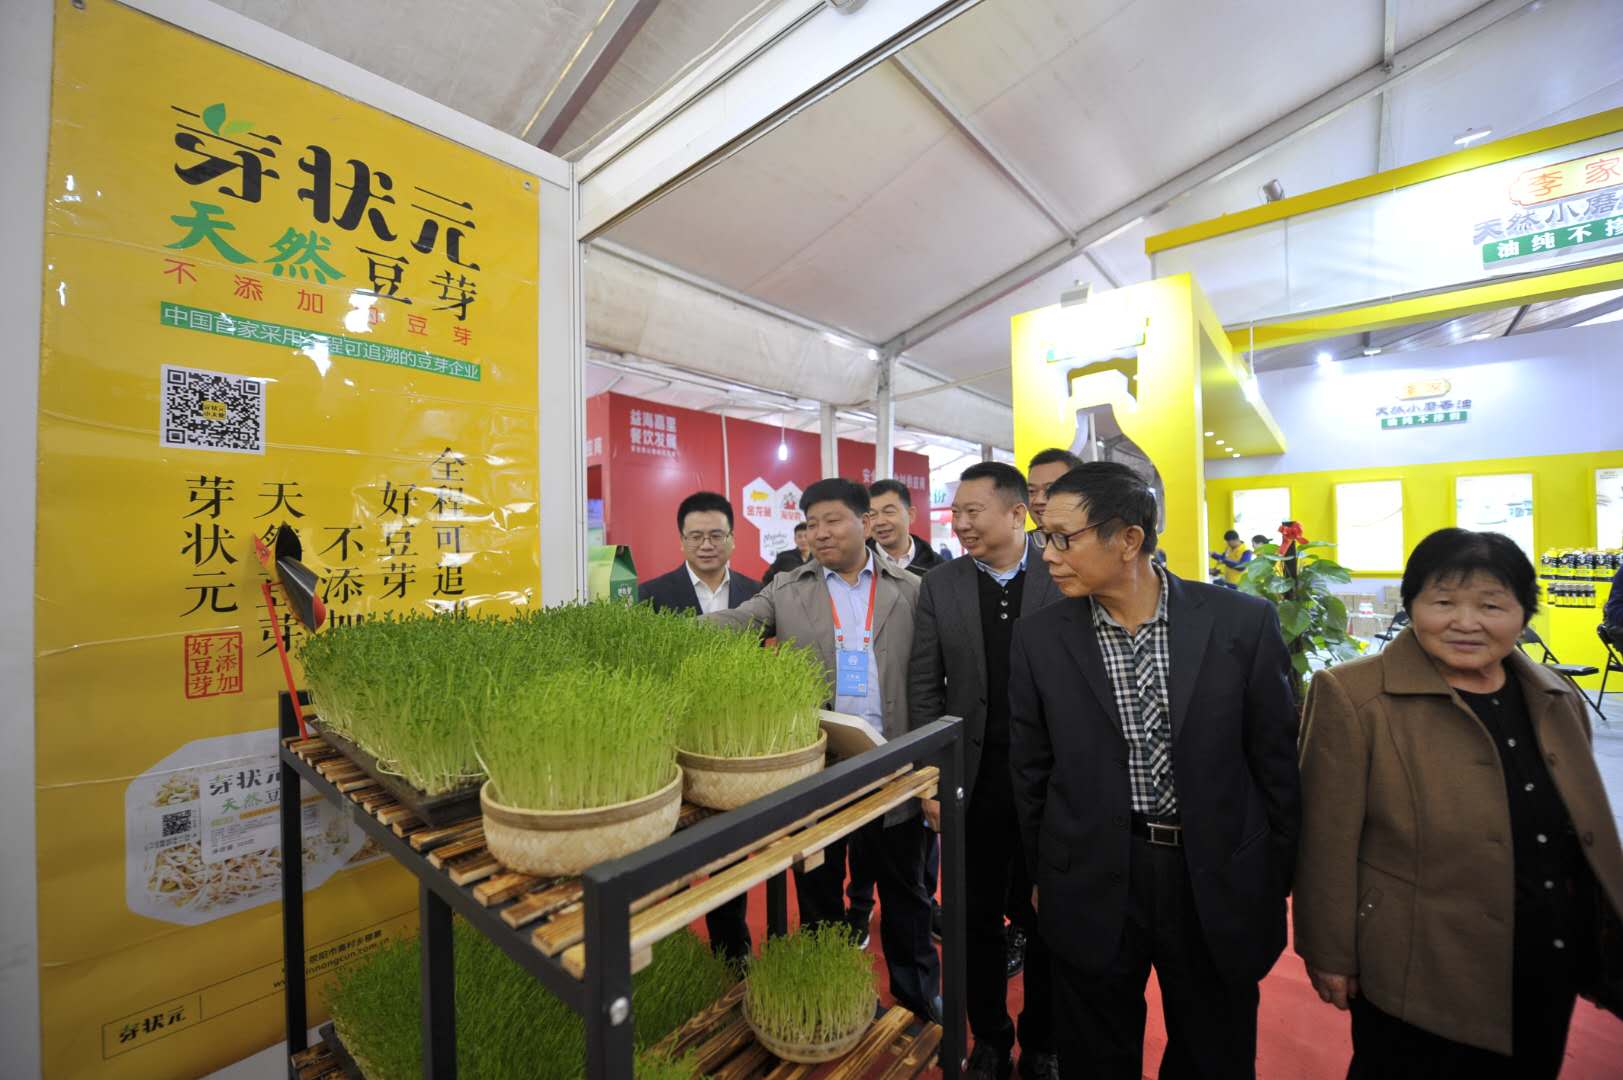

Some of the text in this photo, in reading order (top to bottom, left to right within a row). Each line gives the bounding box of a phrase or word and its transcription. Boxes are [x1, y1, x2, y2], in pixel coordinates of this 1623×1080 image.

[171, 103, 481, 271] 芽状元
[179, 475, 239, 618] 芽状元
[378, 480, 419, 600] 好豆芽
[431, 447, 466, 620] 全程可追
